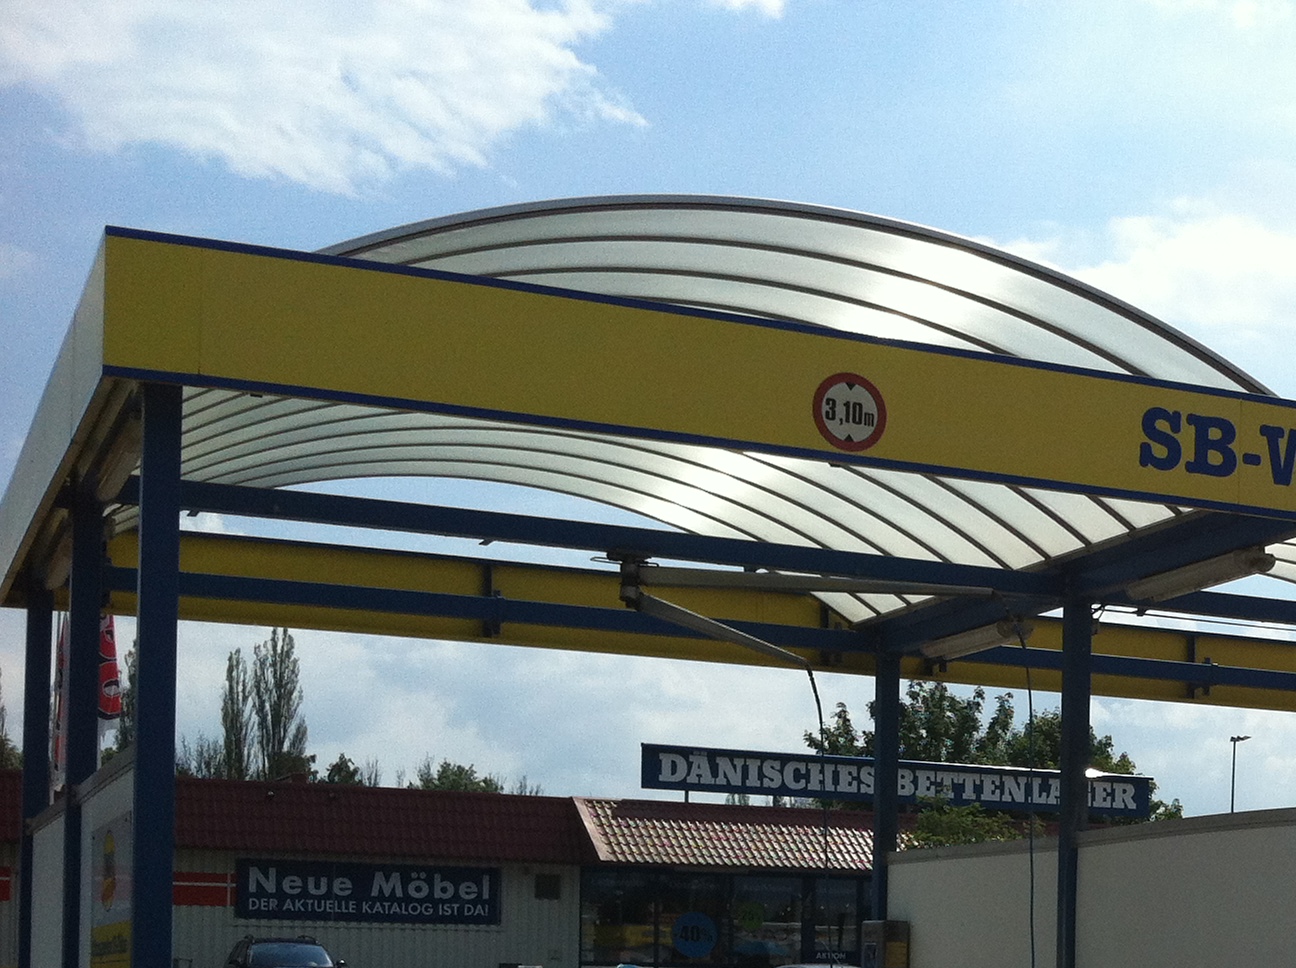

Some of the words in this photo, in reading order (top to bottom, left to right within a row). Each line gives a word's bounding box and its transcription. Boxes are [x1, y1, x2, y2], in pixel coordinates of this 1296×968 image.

[825, 398, 874, 427] 3,10m
[658, 751, 874, 795] DÄNISCHES
[897, 768, 1137, 810] BETTENLAER
[250, 866, 353, 896] Neue
[371, 871, 490, 900] Möbel
[249, 898, 278, 911] DER
[283, 899, 356, 914] AKTUELLE
[362, 901, 433, 916] KATALOG
[438, 903, 461, 917] IST
[464, 903, 489, 917] DA!
